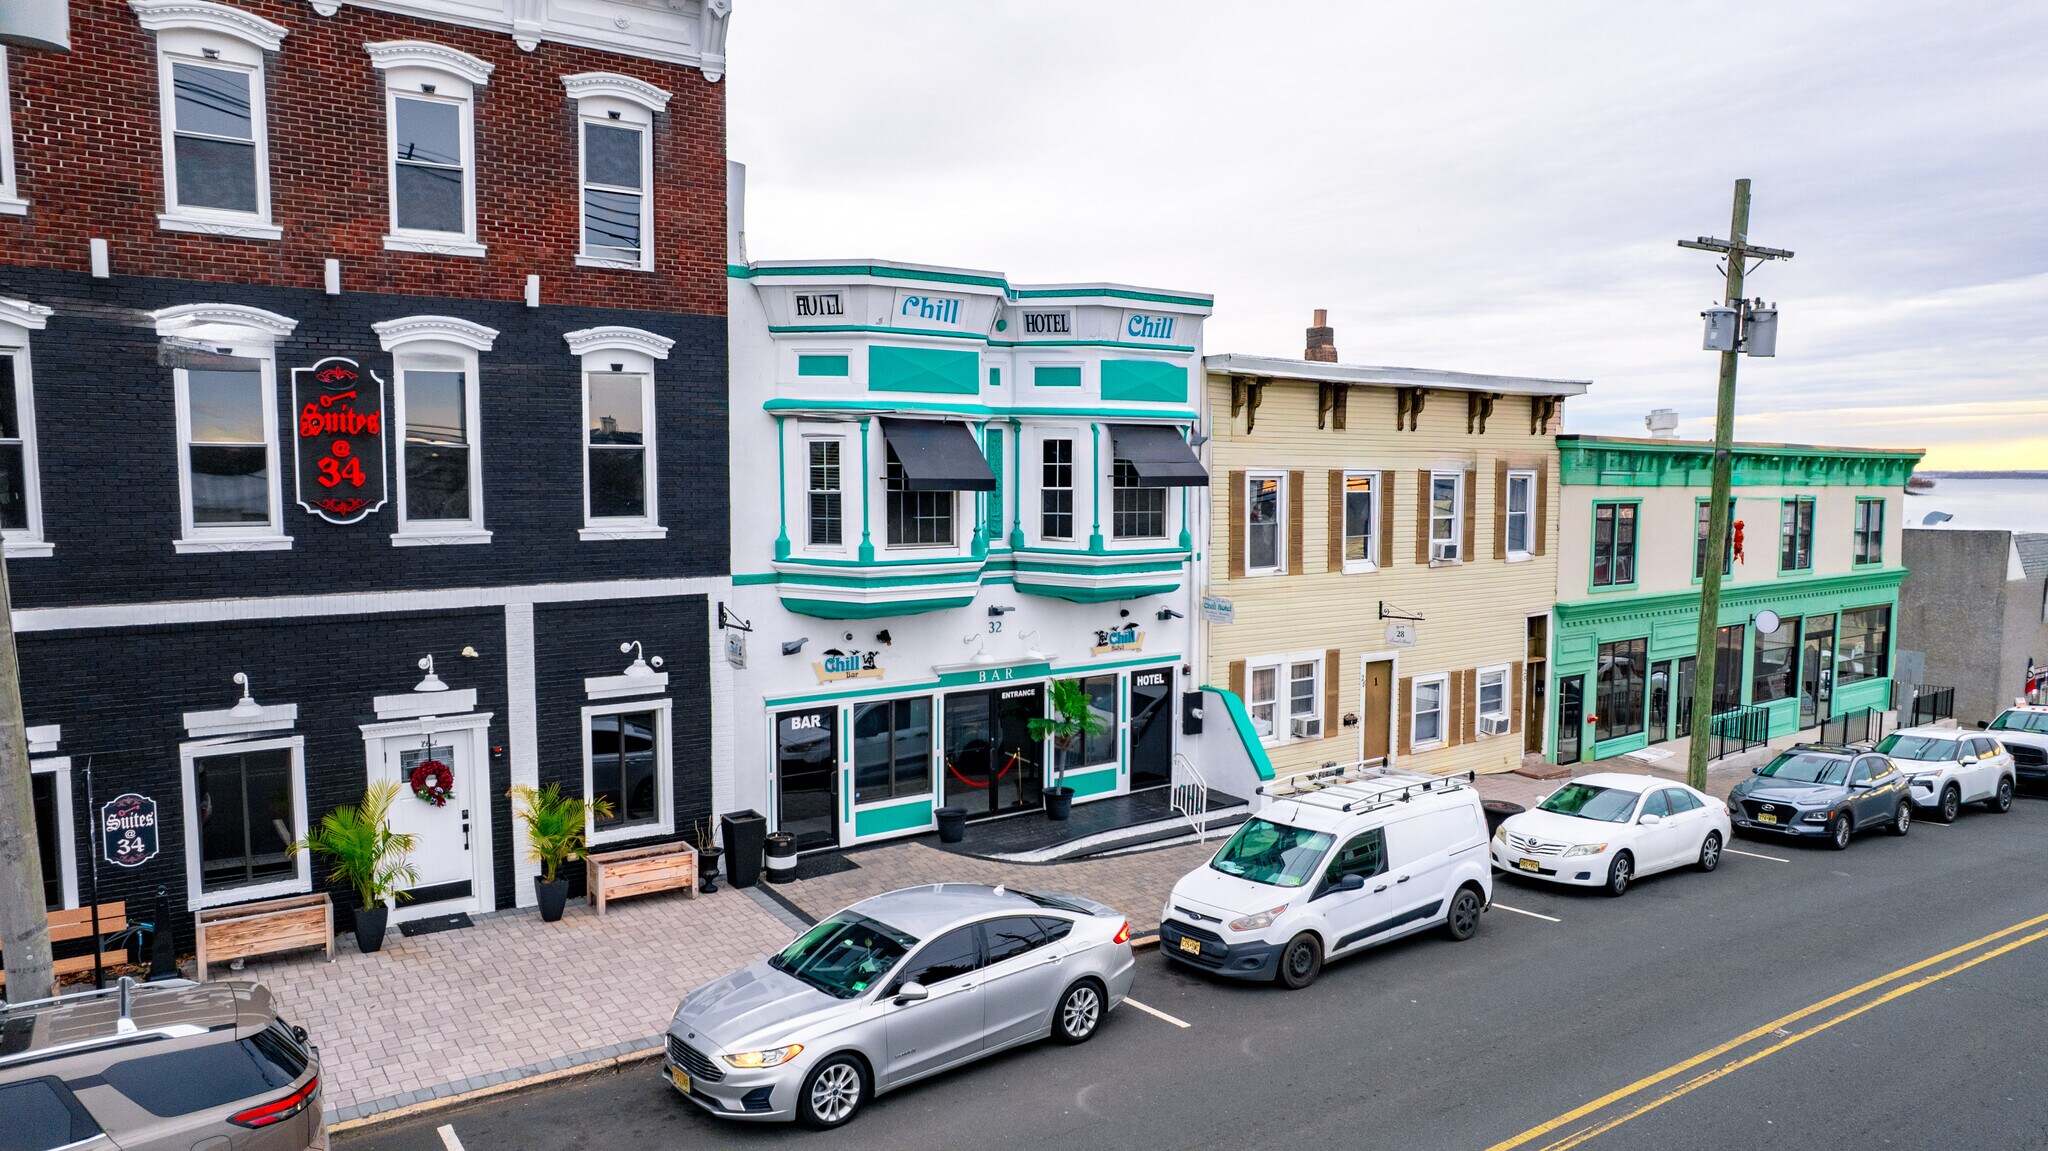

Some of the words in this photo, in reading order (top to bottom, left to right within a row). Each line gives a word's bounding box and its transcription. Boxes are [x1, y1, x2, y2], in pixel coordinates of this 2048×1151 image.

[902, 296, 959, 323] Chill
[1025, 313, 1070, 333] HOTEL
[1128, 314, 1174, 339] Chill
[300, 402, 380, 437] Suites
[331, 439, 351, 458] @
[317, 456, 366, 488] 34
[988, 620, 1002, 634] 32
[1396, 630, 1405, 638] 28
[1109, 629, 1136, 645] Chill
[824, 655, 861, 673] Chill
[978, 667, 1014, 683] BAR
[1136, 673, 1165, 687] HOTEL
[1001, 688, 1036, 700] ENTRANCE
[791, 714, 821, 731] BAR
[106, 811, 154, 832] Suites
[124, 829, 136, 839] @
[116, 836, 145, 855] 34
